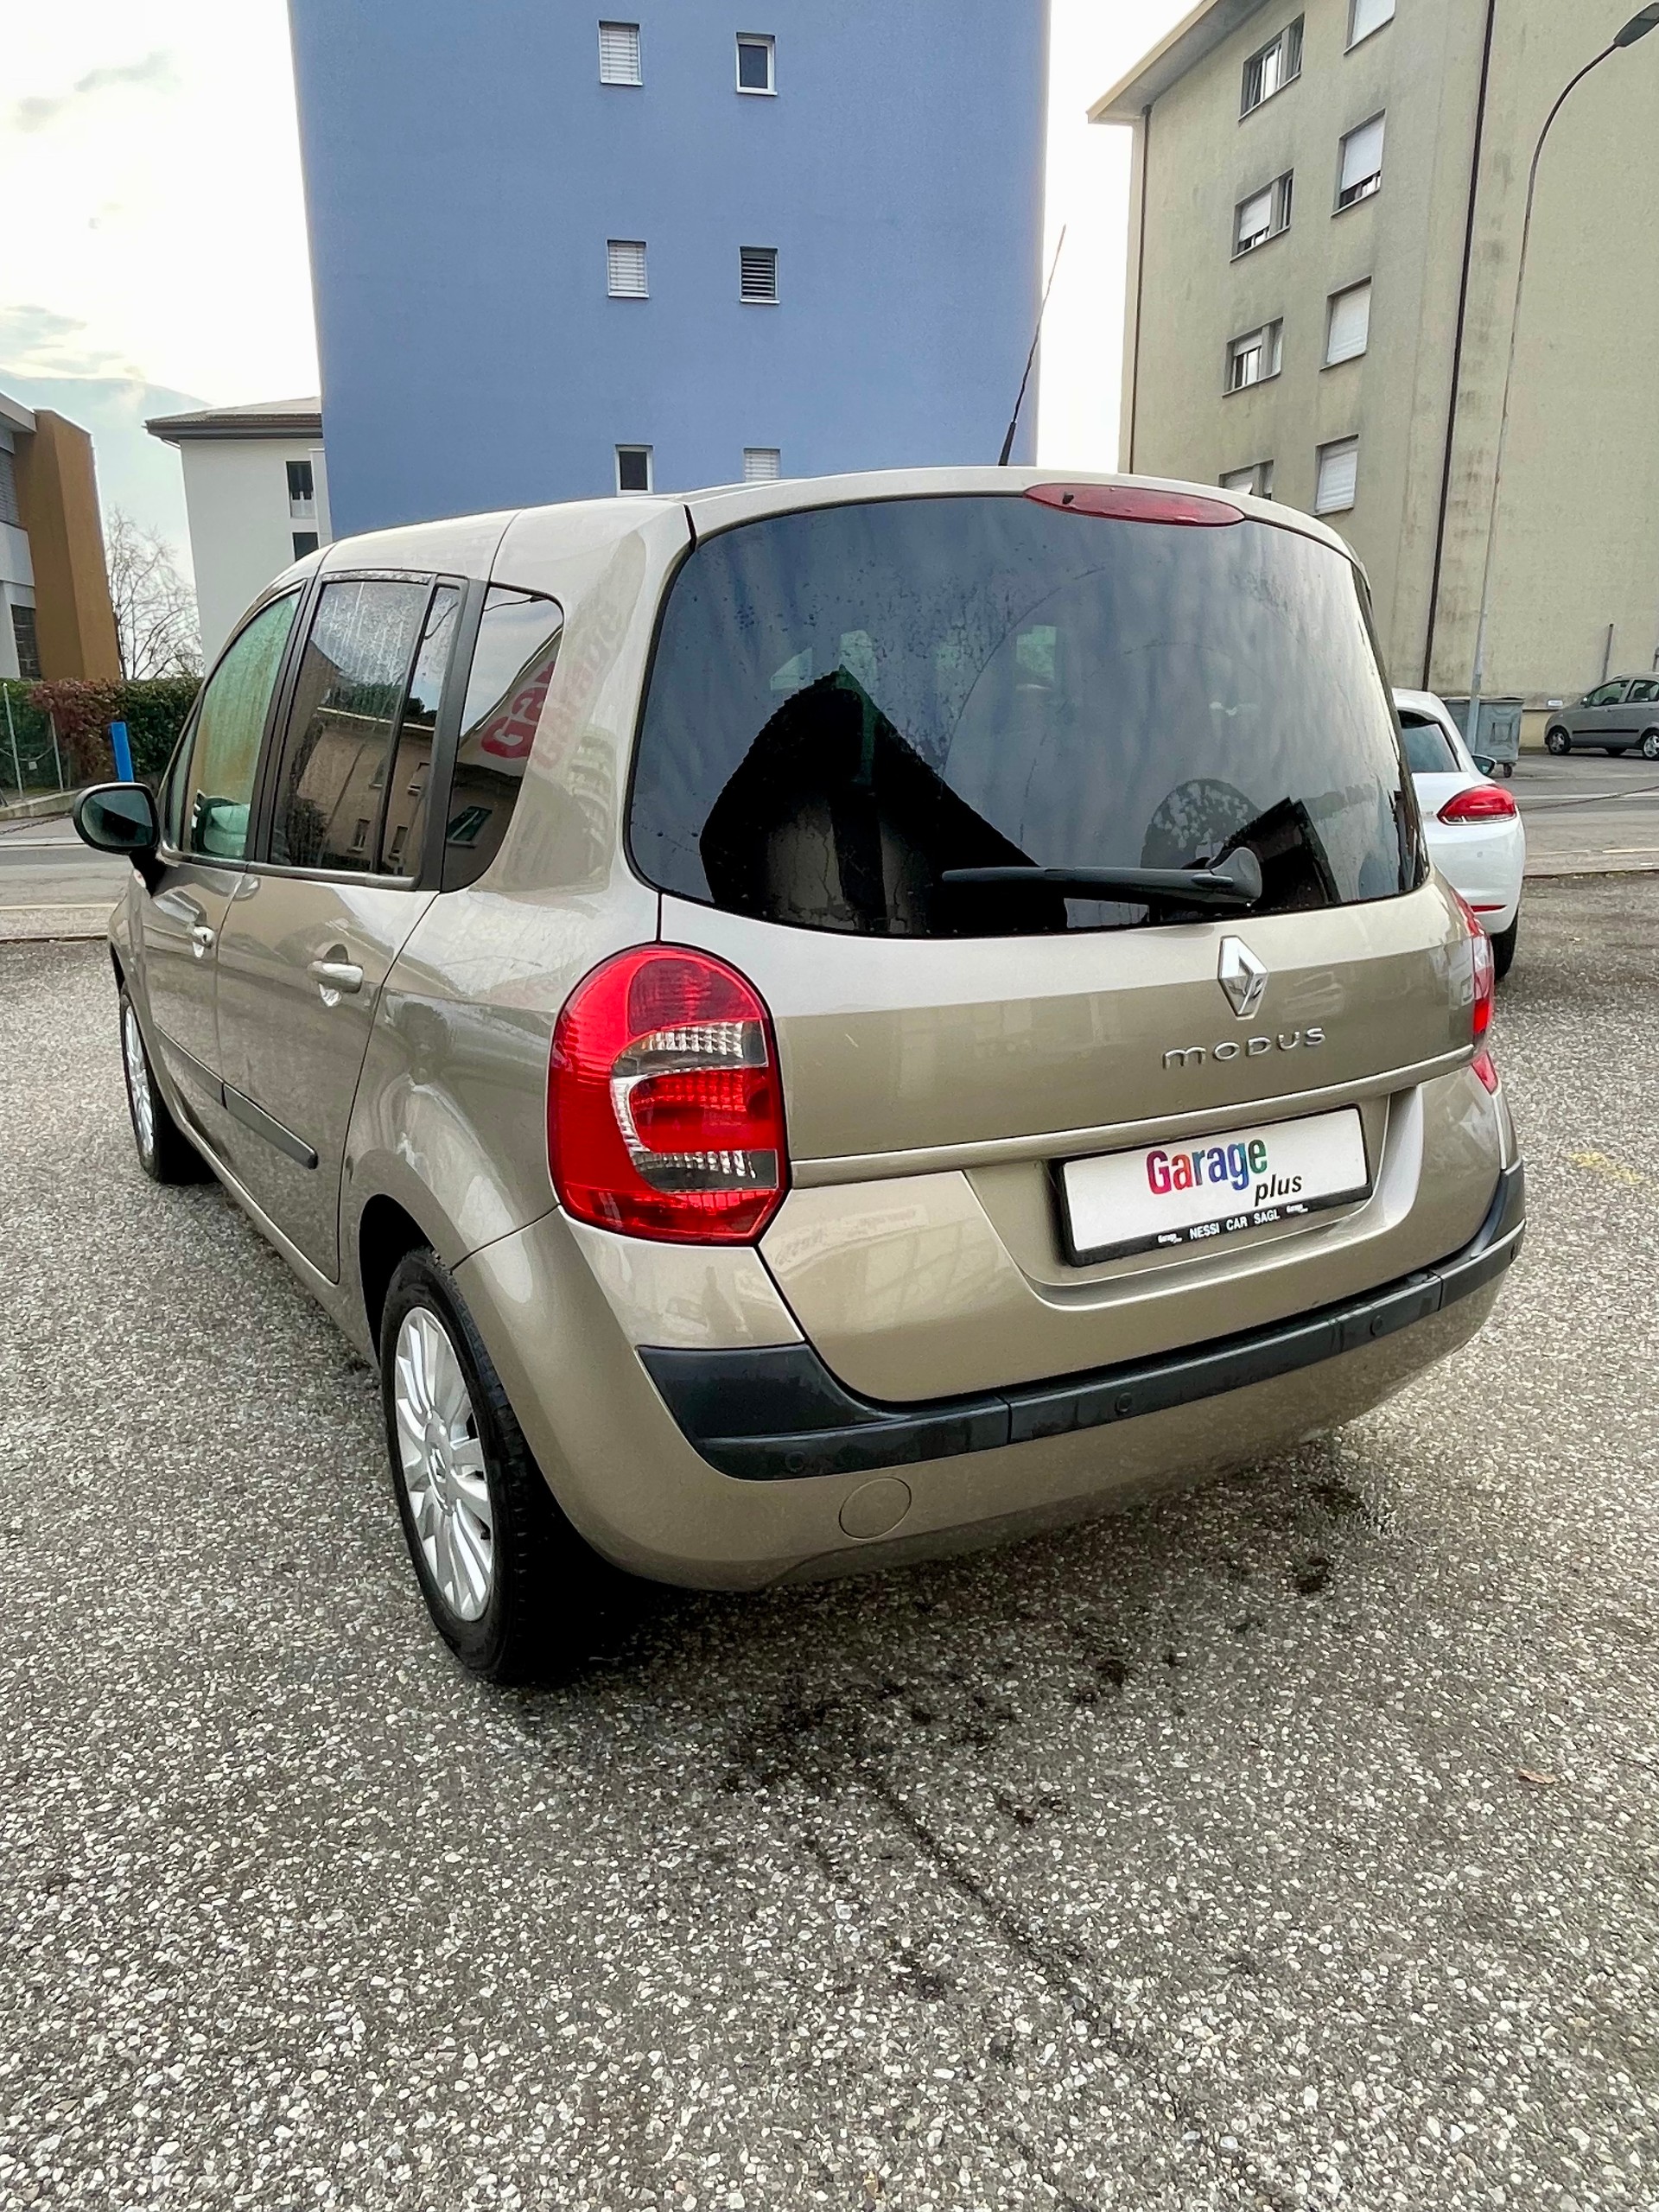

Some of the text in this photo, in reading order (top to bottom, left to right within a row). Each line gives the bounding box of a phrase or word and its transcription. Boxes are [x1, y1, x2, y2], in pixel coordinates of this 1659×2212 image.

[1146, 1139, 1268, 1195] Garage
[1255, 1174, 1302, 1207] plus
[1189, 1223, 1220, 1240] NESSI
[1226, 1216, 1248, 1230] CAR
[1254, 1209, 1280, 1224] SAGL
